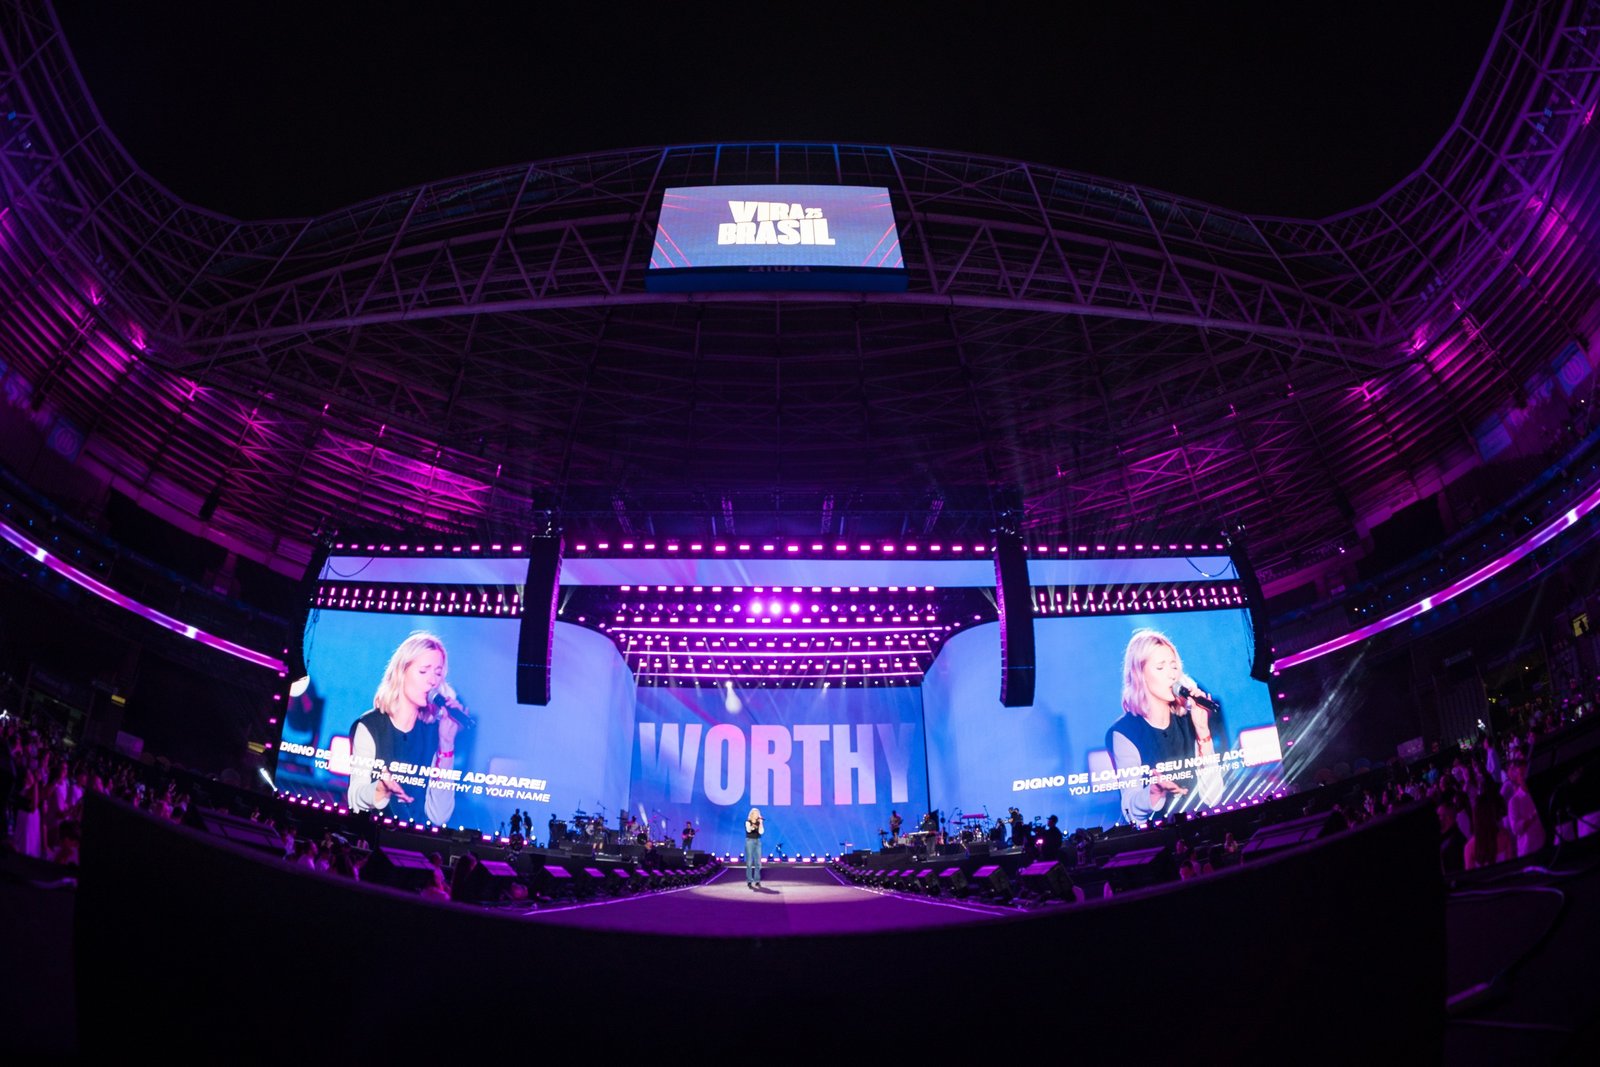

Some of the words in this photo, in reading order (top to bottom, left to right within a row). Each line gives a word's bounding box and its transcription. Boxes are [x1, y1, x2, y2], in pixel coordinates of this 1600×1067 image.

[728, 200, 805, 222] VIRA
[804, 208, 823, 219] 25
[717, 218, 836, 246] BRASIL
[280, 741, 315, 757] DIGNO
[315, 748, 333, 760] DE
[389, 761, 418, 775] SEU
[419, 765, 462, 781] NOME
[314, 759, 330, 770] YOU
[371, 770, 390, 782] THE
[390, 774, 426, 788] PRAISE,
[429, 780, 471, 793] WORTHY
[472, 785, 483, 795] IS
[485, 787, 514, 798] YOUR
[516, 790, 551, 802] NAME
[639, 722, 915, 806] WORTHY
[1012, 775, 1065, 791] DIGNO
[1068, 772, 1089, 785] DE
[1091, 764, 1152, 782] LOUVOR,
[1155, 759, 1182, 773] SEU
[1185, 752, 1220, 768] NOME
[1069, 785, 1090, 796] YOU
[1092, 779, 1138, 793] DESERVE
[1140, 775, 1158, 786] THE
[1160, 770, 1194, 783] PRAISE,
[1232, 761, 1240, 770] IS
